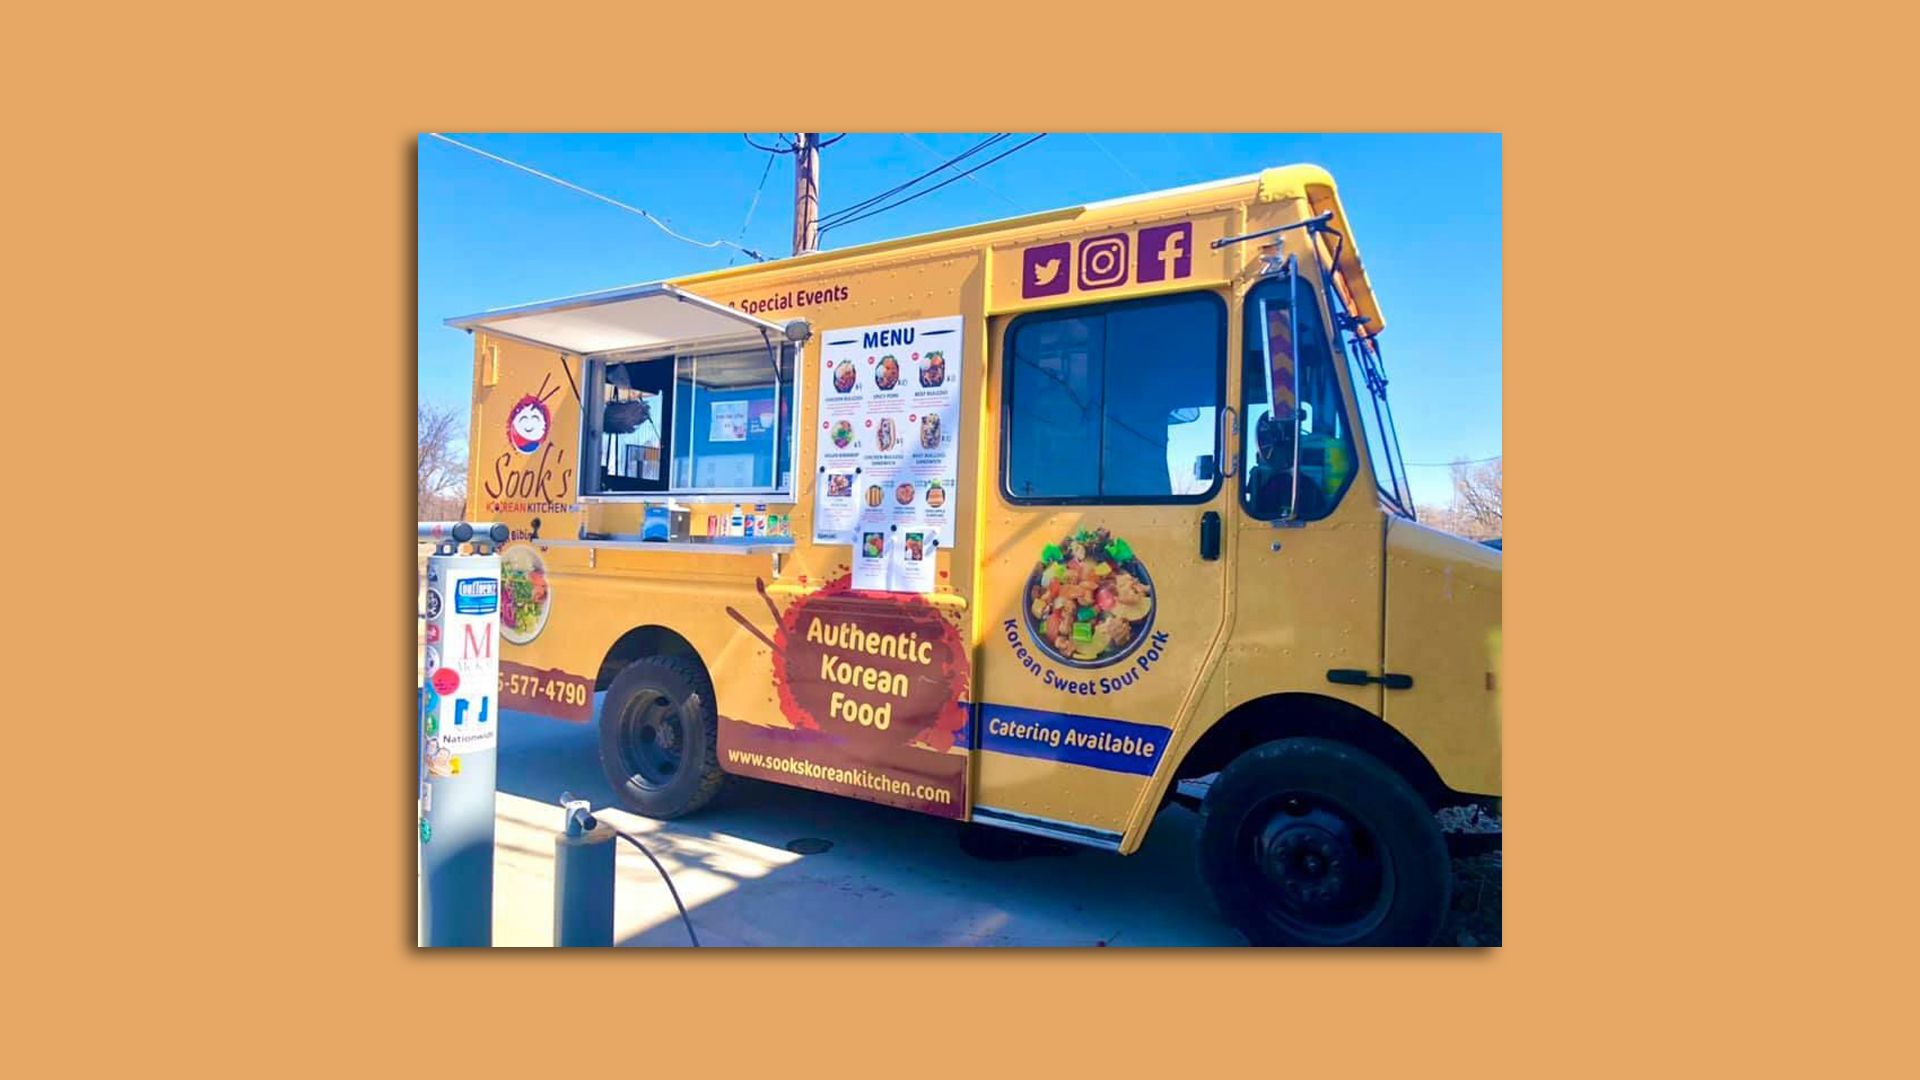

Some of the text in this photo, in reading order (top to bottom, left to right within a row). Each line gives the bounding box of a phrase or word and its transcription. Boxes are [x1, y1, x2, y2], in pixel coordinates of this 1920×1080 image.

[741, 285, 849, 315] Special Events
[863, 327, 915, 350] MENU
[485, 442, 573, 504] Sook's
[527, 502, 568, 514] KITCHEN
[462, 622, 492, 660] M
[807, 617, 933, 665] Authentic
[1004, 618, 1169, 696] Korean Sweet Sour Pork
[821, 653, 908, 697] Korean
[830, 691, 891, 730] Food
[989, 718, 1155, 758] Catering Available
[728, 749, 951, 804] www.sookskoreankitchen.com
